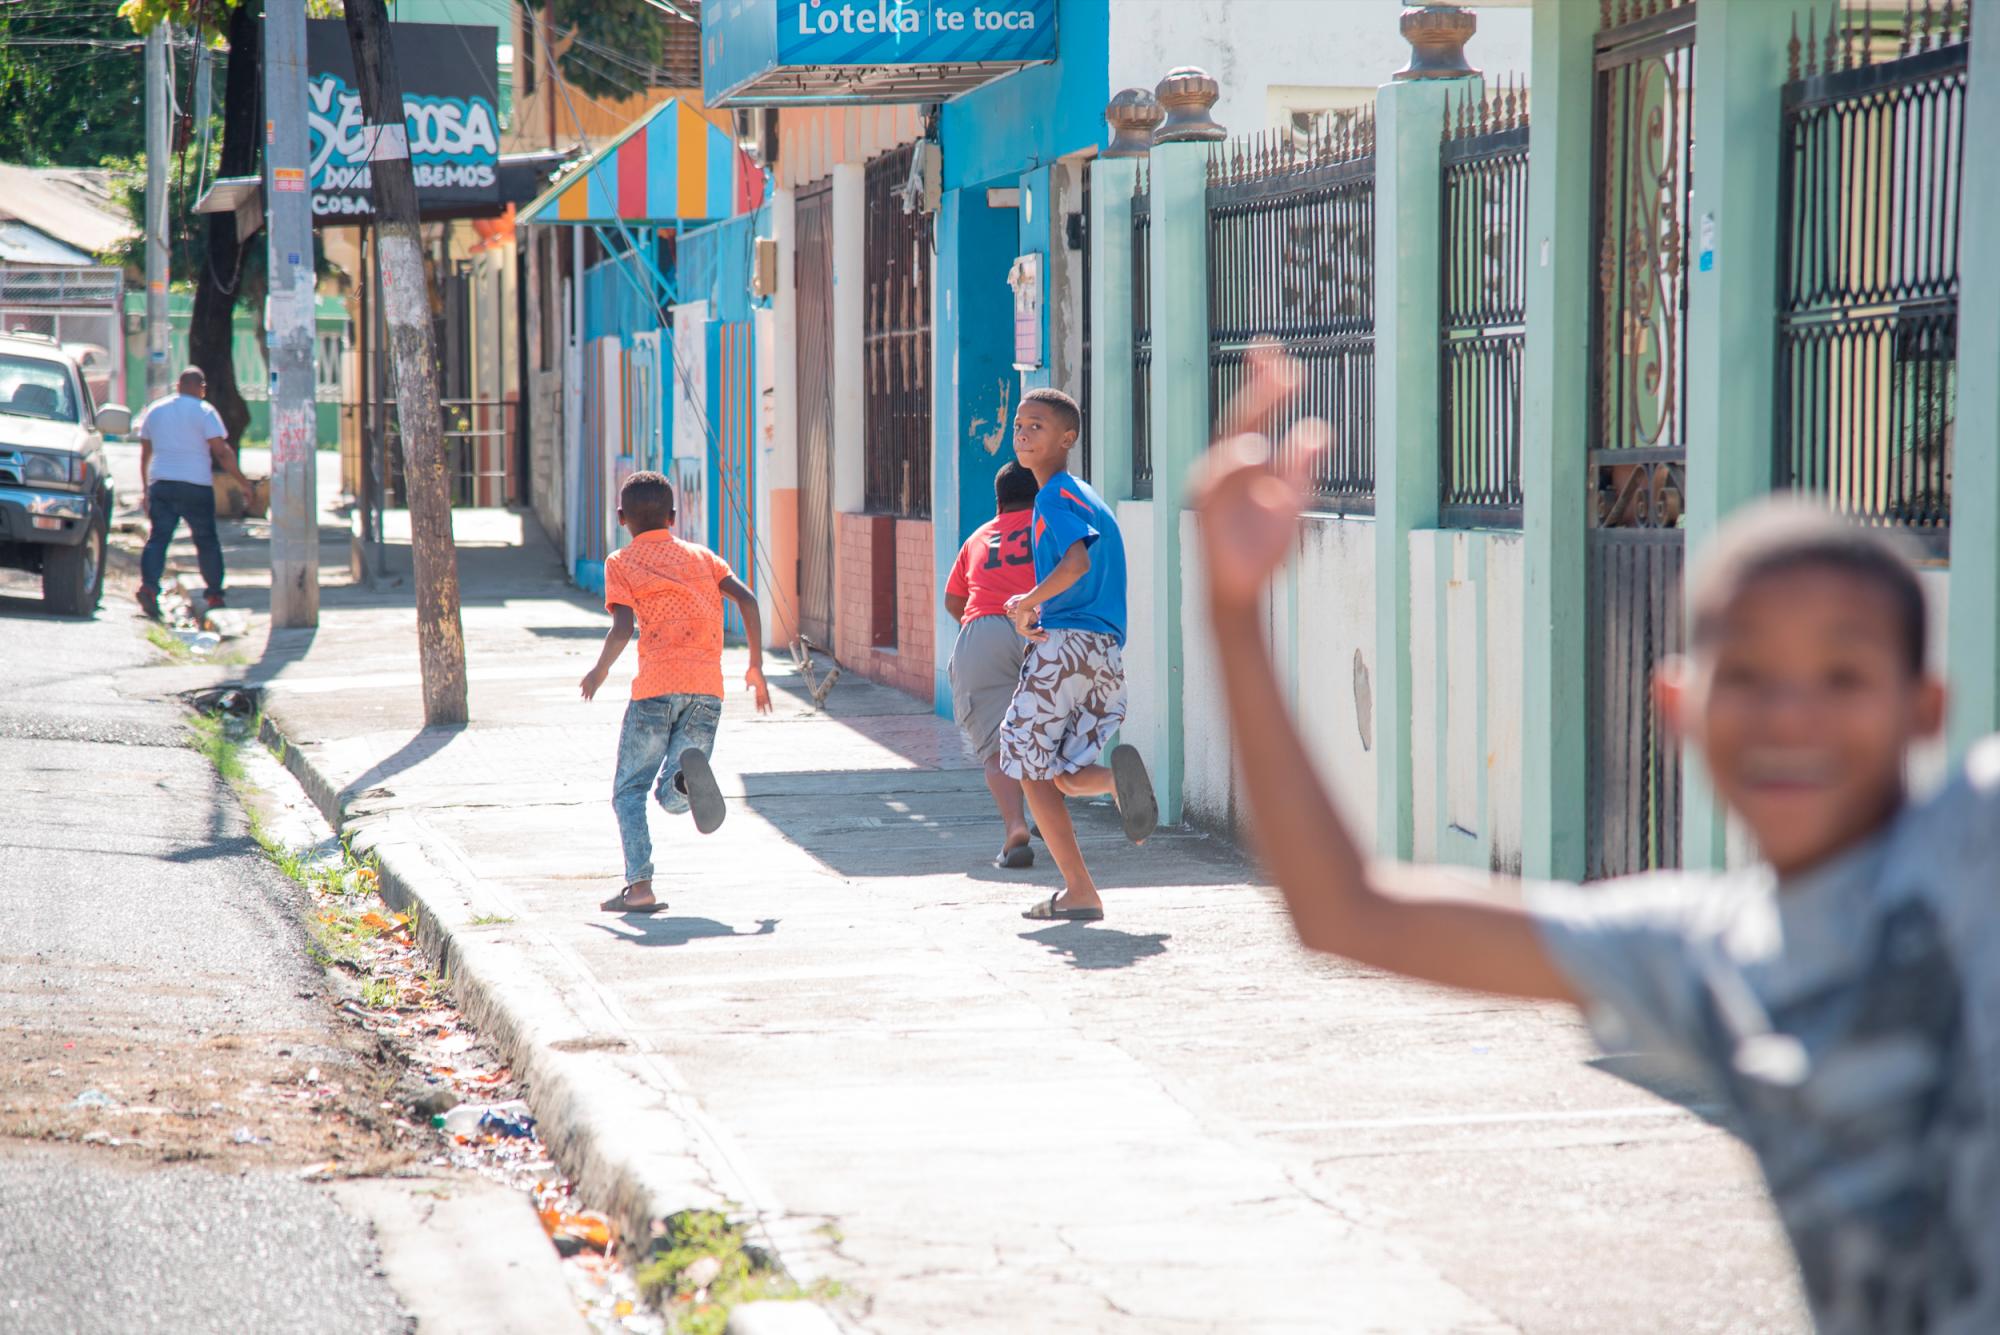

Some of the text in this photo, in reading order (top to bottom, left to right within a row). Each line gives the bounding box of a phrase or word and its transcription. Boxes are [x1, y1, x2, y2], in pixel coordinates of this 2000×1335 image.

[799, 0, 1035, 34] Loteka te toca
[983, 526, 1034, 570] 13
